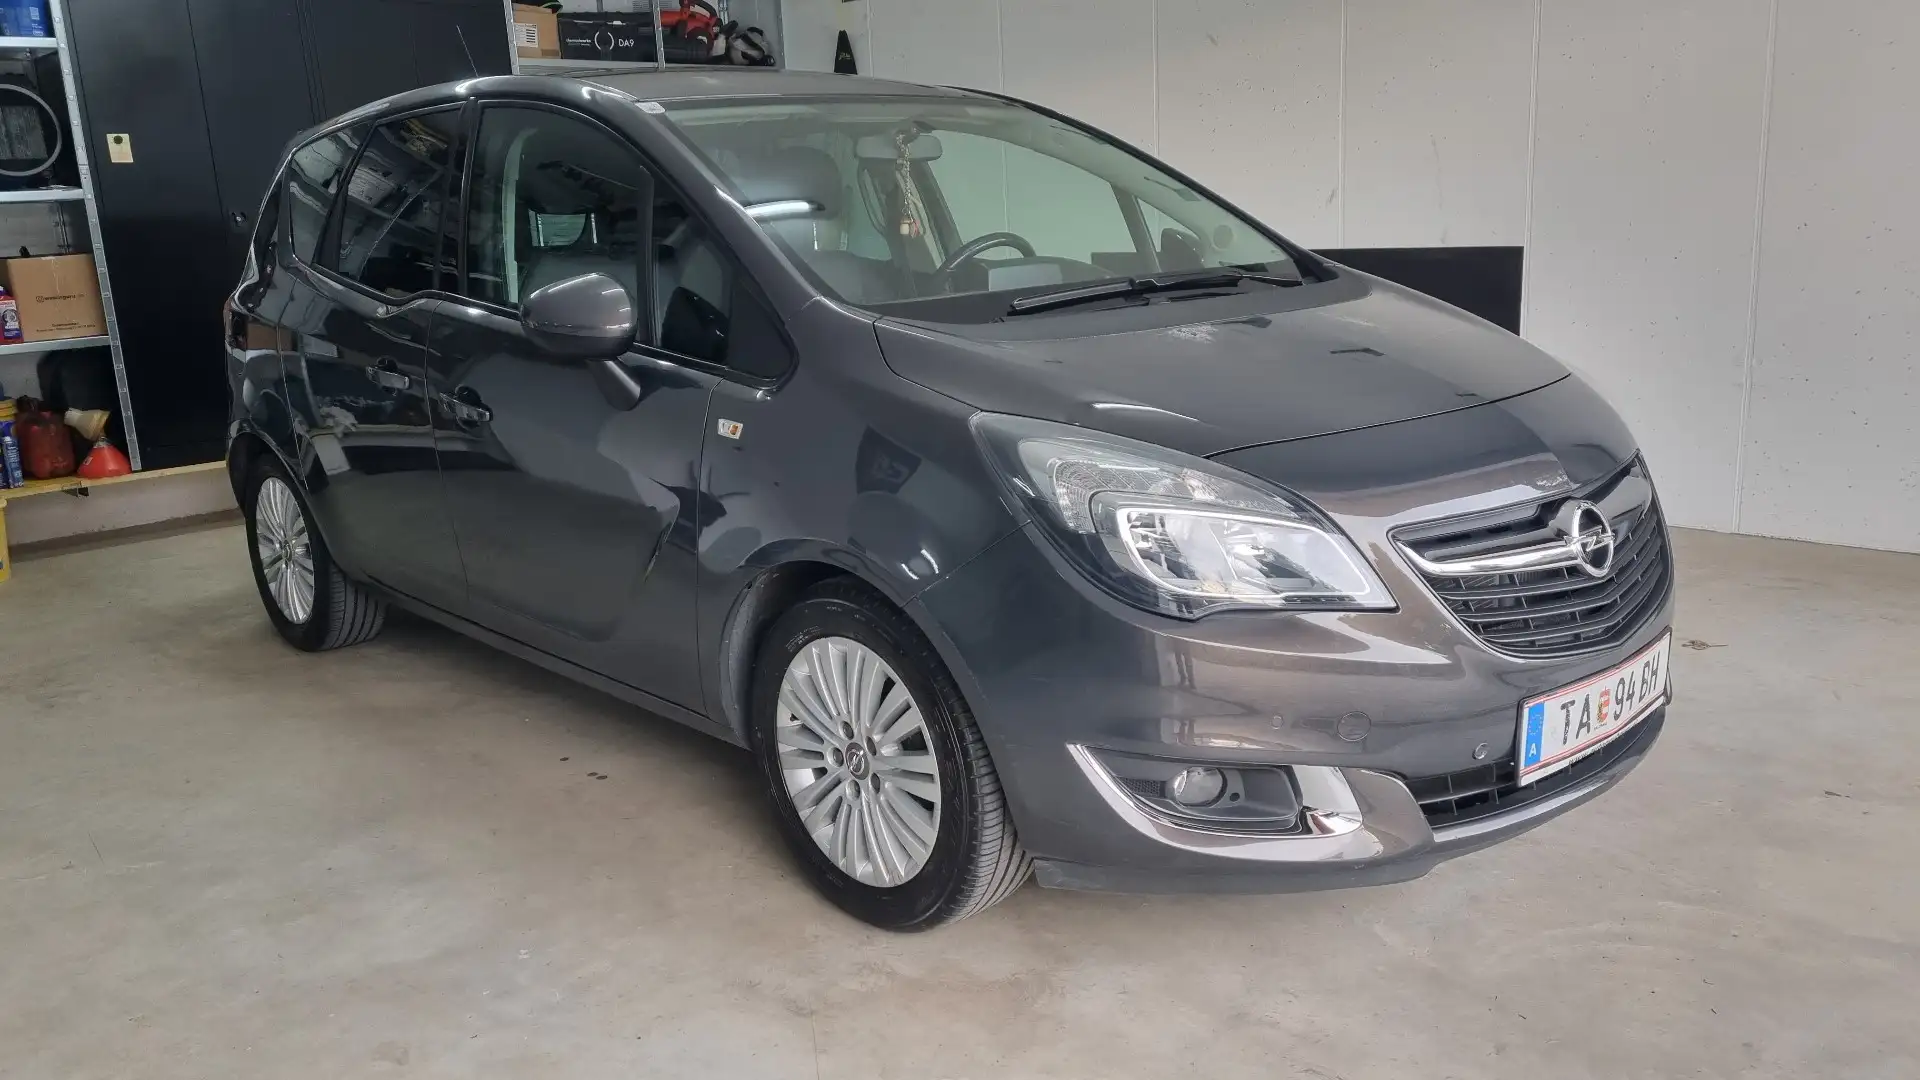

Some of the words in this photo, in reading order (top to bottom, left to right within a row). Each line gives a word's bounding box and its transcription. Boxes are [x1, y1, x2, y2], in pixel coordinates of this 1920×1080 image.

[618, 38, 635, 47] DA9
[1560, 693, 1591, 745] TA
[1613, 670, 1636, 721] 94
[1639, 650, 1661, 704] BH
[1529, 743, 1537, 757] A
